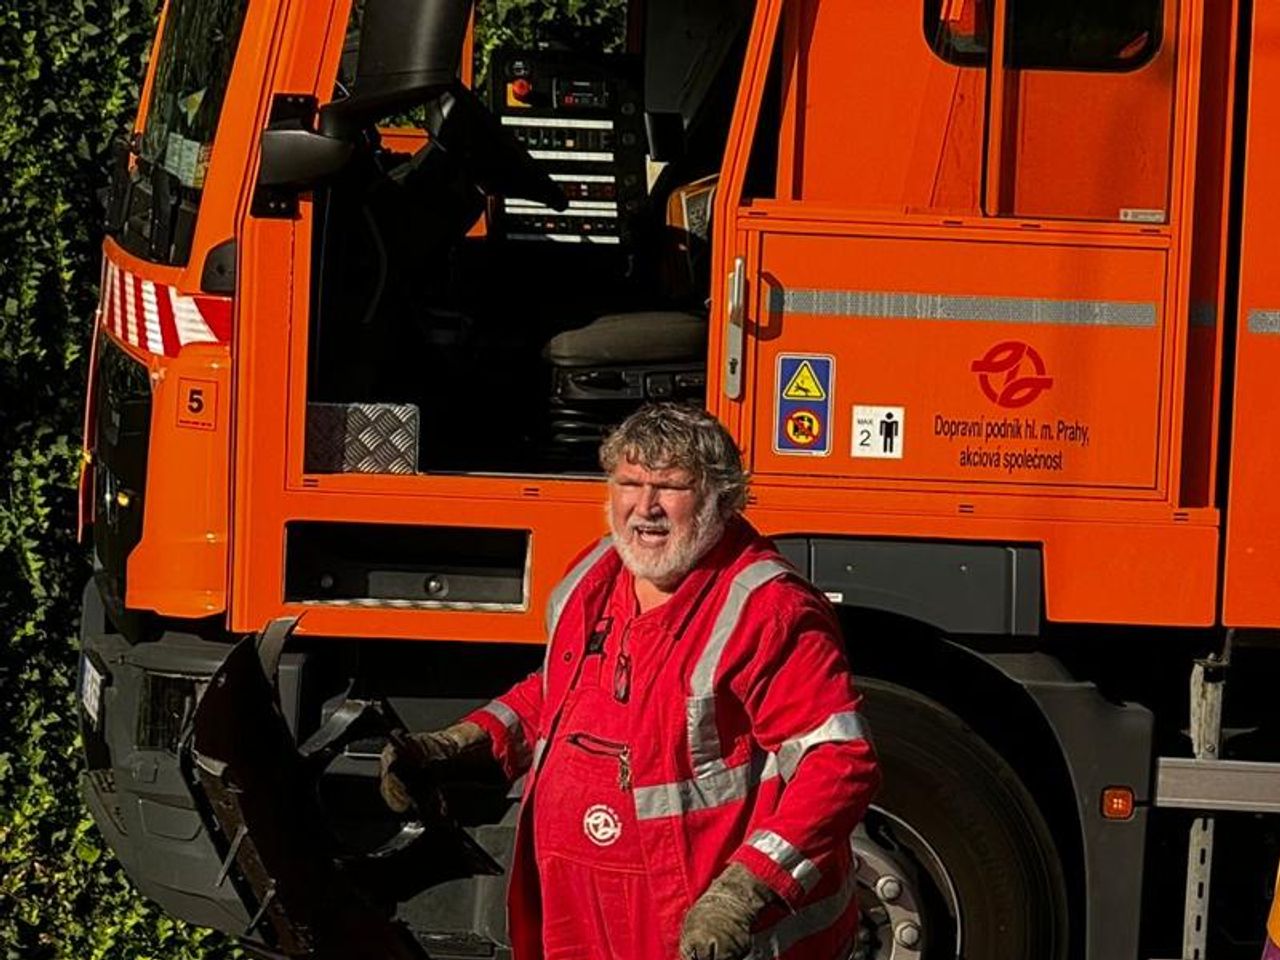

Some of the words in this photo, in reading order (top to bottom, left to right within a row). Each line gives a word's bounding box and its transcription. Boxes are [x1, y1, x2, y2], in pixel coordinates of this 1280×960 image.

[188, 388, 204, 414] 5
[856, 418, 873, 426] MAX
[934, 415, 983, 439] Dopravní
[985, 417, 1022, 441] podnik
[1025, 420, 1038, 440] hl.
[1040, 424, 1054, 441] m.
[1056, 421, 1090, 446] Prahy,
[859, 430, 872, 447] 2
[960, 445, 1001, 468] akciová
[1003, 449, 1063, 473] společnost
